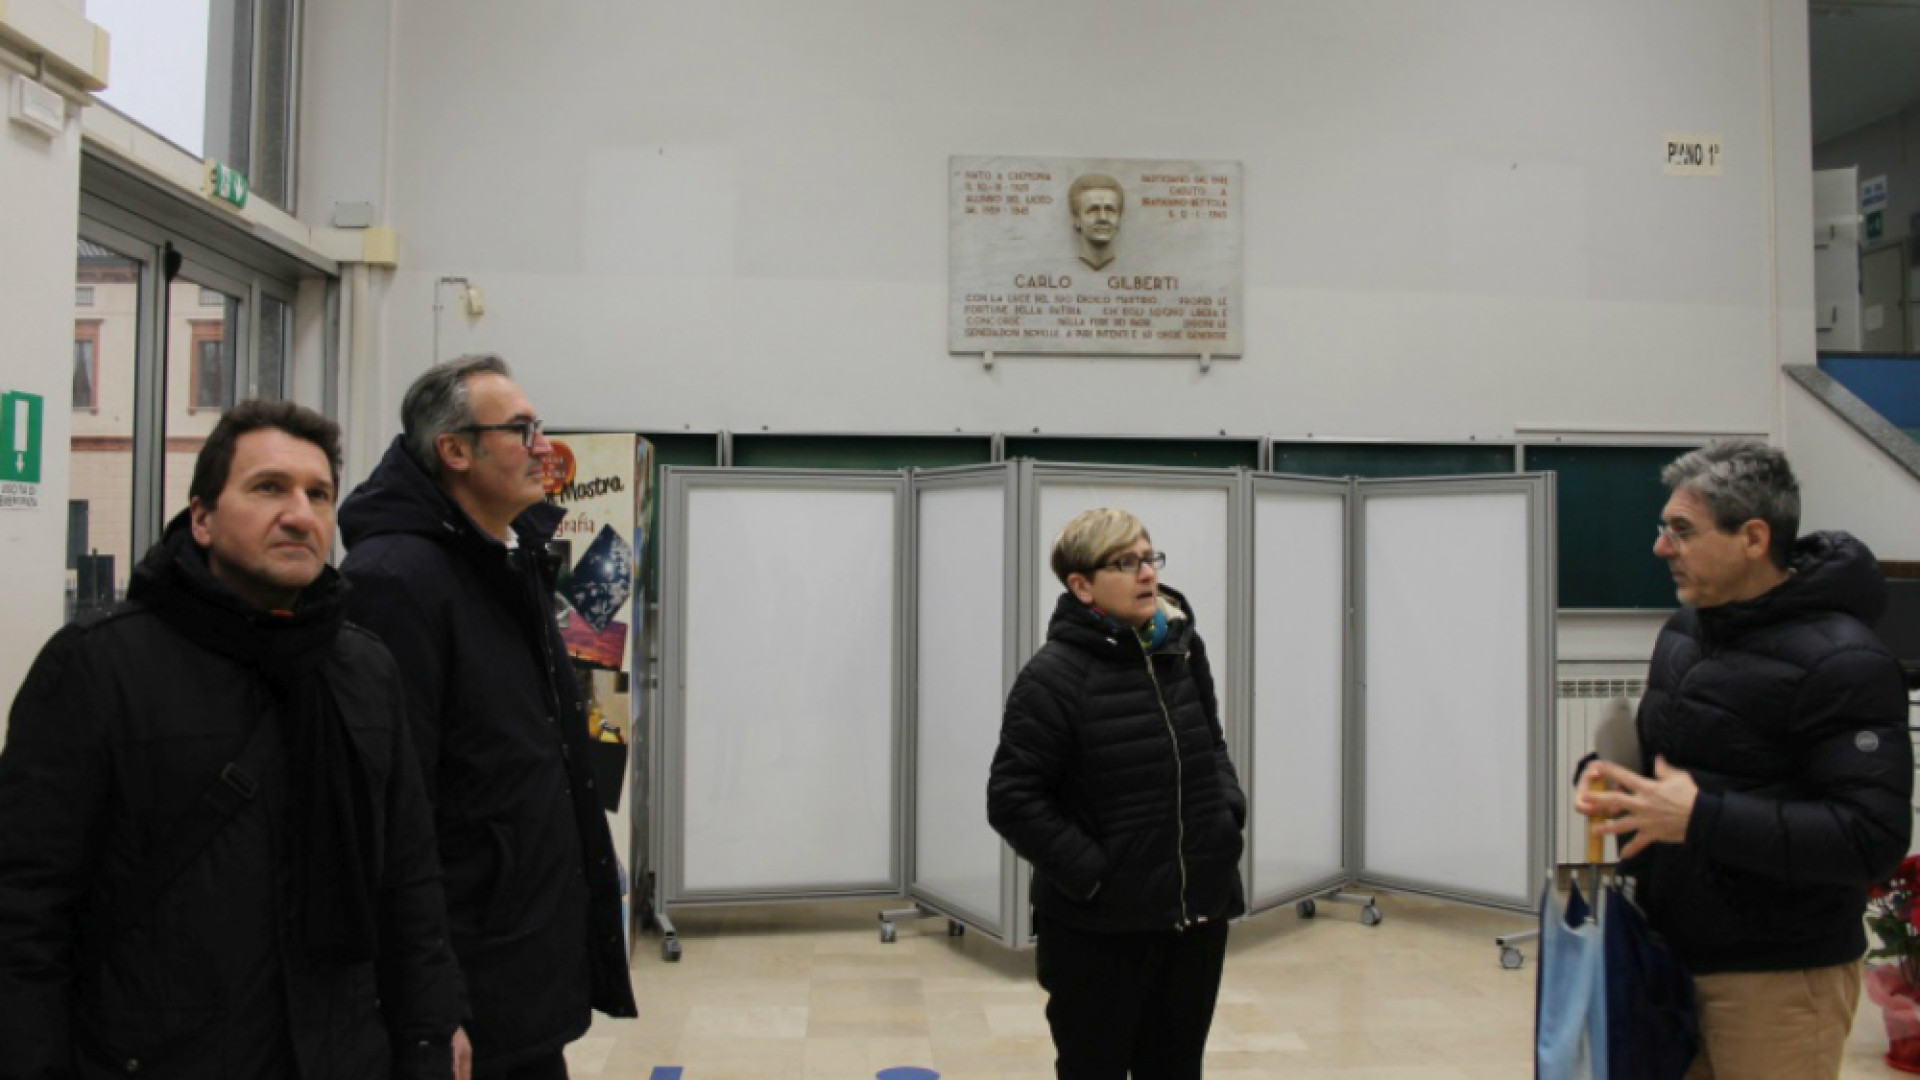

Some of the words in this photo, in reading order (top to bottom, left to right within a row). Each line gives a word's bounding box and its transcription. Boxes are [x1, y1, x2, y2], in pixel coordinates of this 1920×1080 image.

[1668, 142, 1703, 166] PIANO
[1014, 273, 1072, 289] CARLO
[1107, 275, 1180, 291] GILBERTI
[964, 293, 988, 302] CON
[963, 304, 1009, 315] FORTUNE
[556, 511, 595, 538] grafia
